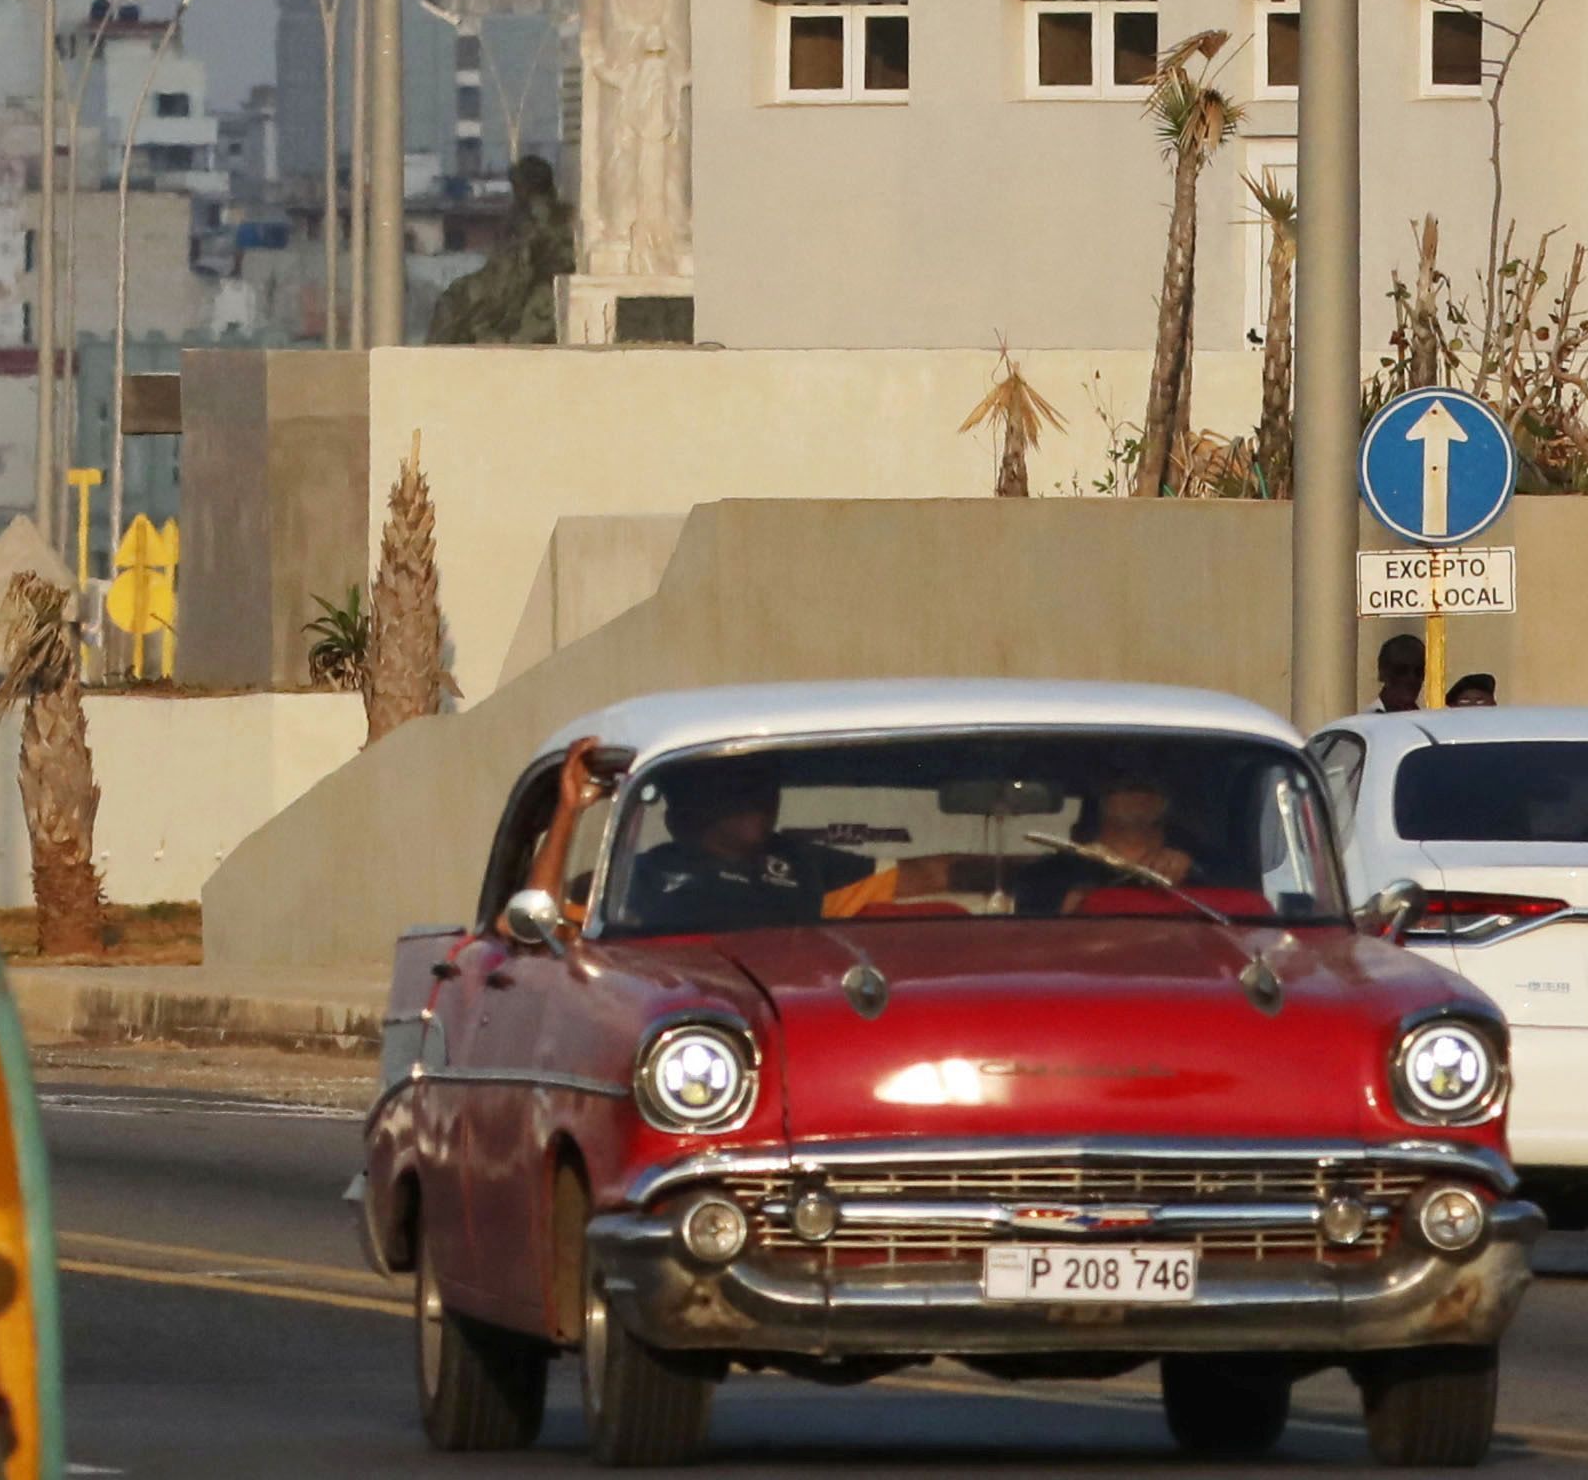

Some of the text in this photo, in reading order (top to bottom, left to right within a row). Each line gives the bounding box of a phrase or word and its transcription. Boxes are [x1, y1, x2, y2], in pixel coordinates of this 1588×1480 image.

[1386, 558, 1485, 579] EXCEPTO
[1369, 587, 1504, 608] CIRC. LOCAL
[1030, 1258, 1052, 1289] P
[1065, 1258, 1120, 1290] 208
[1134, 1259, 1189, 1291] 746
